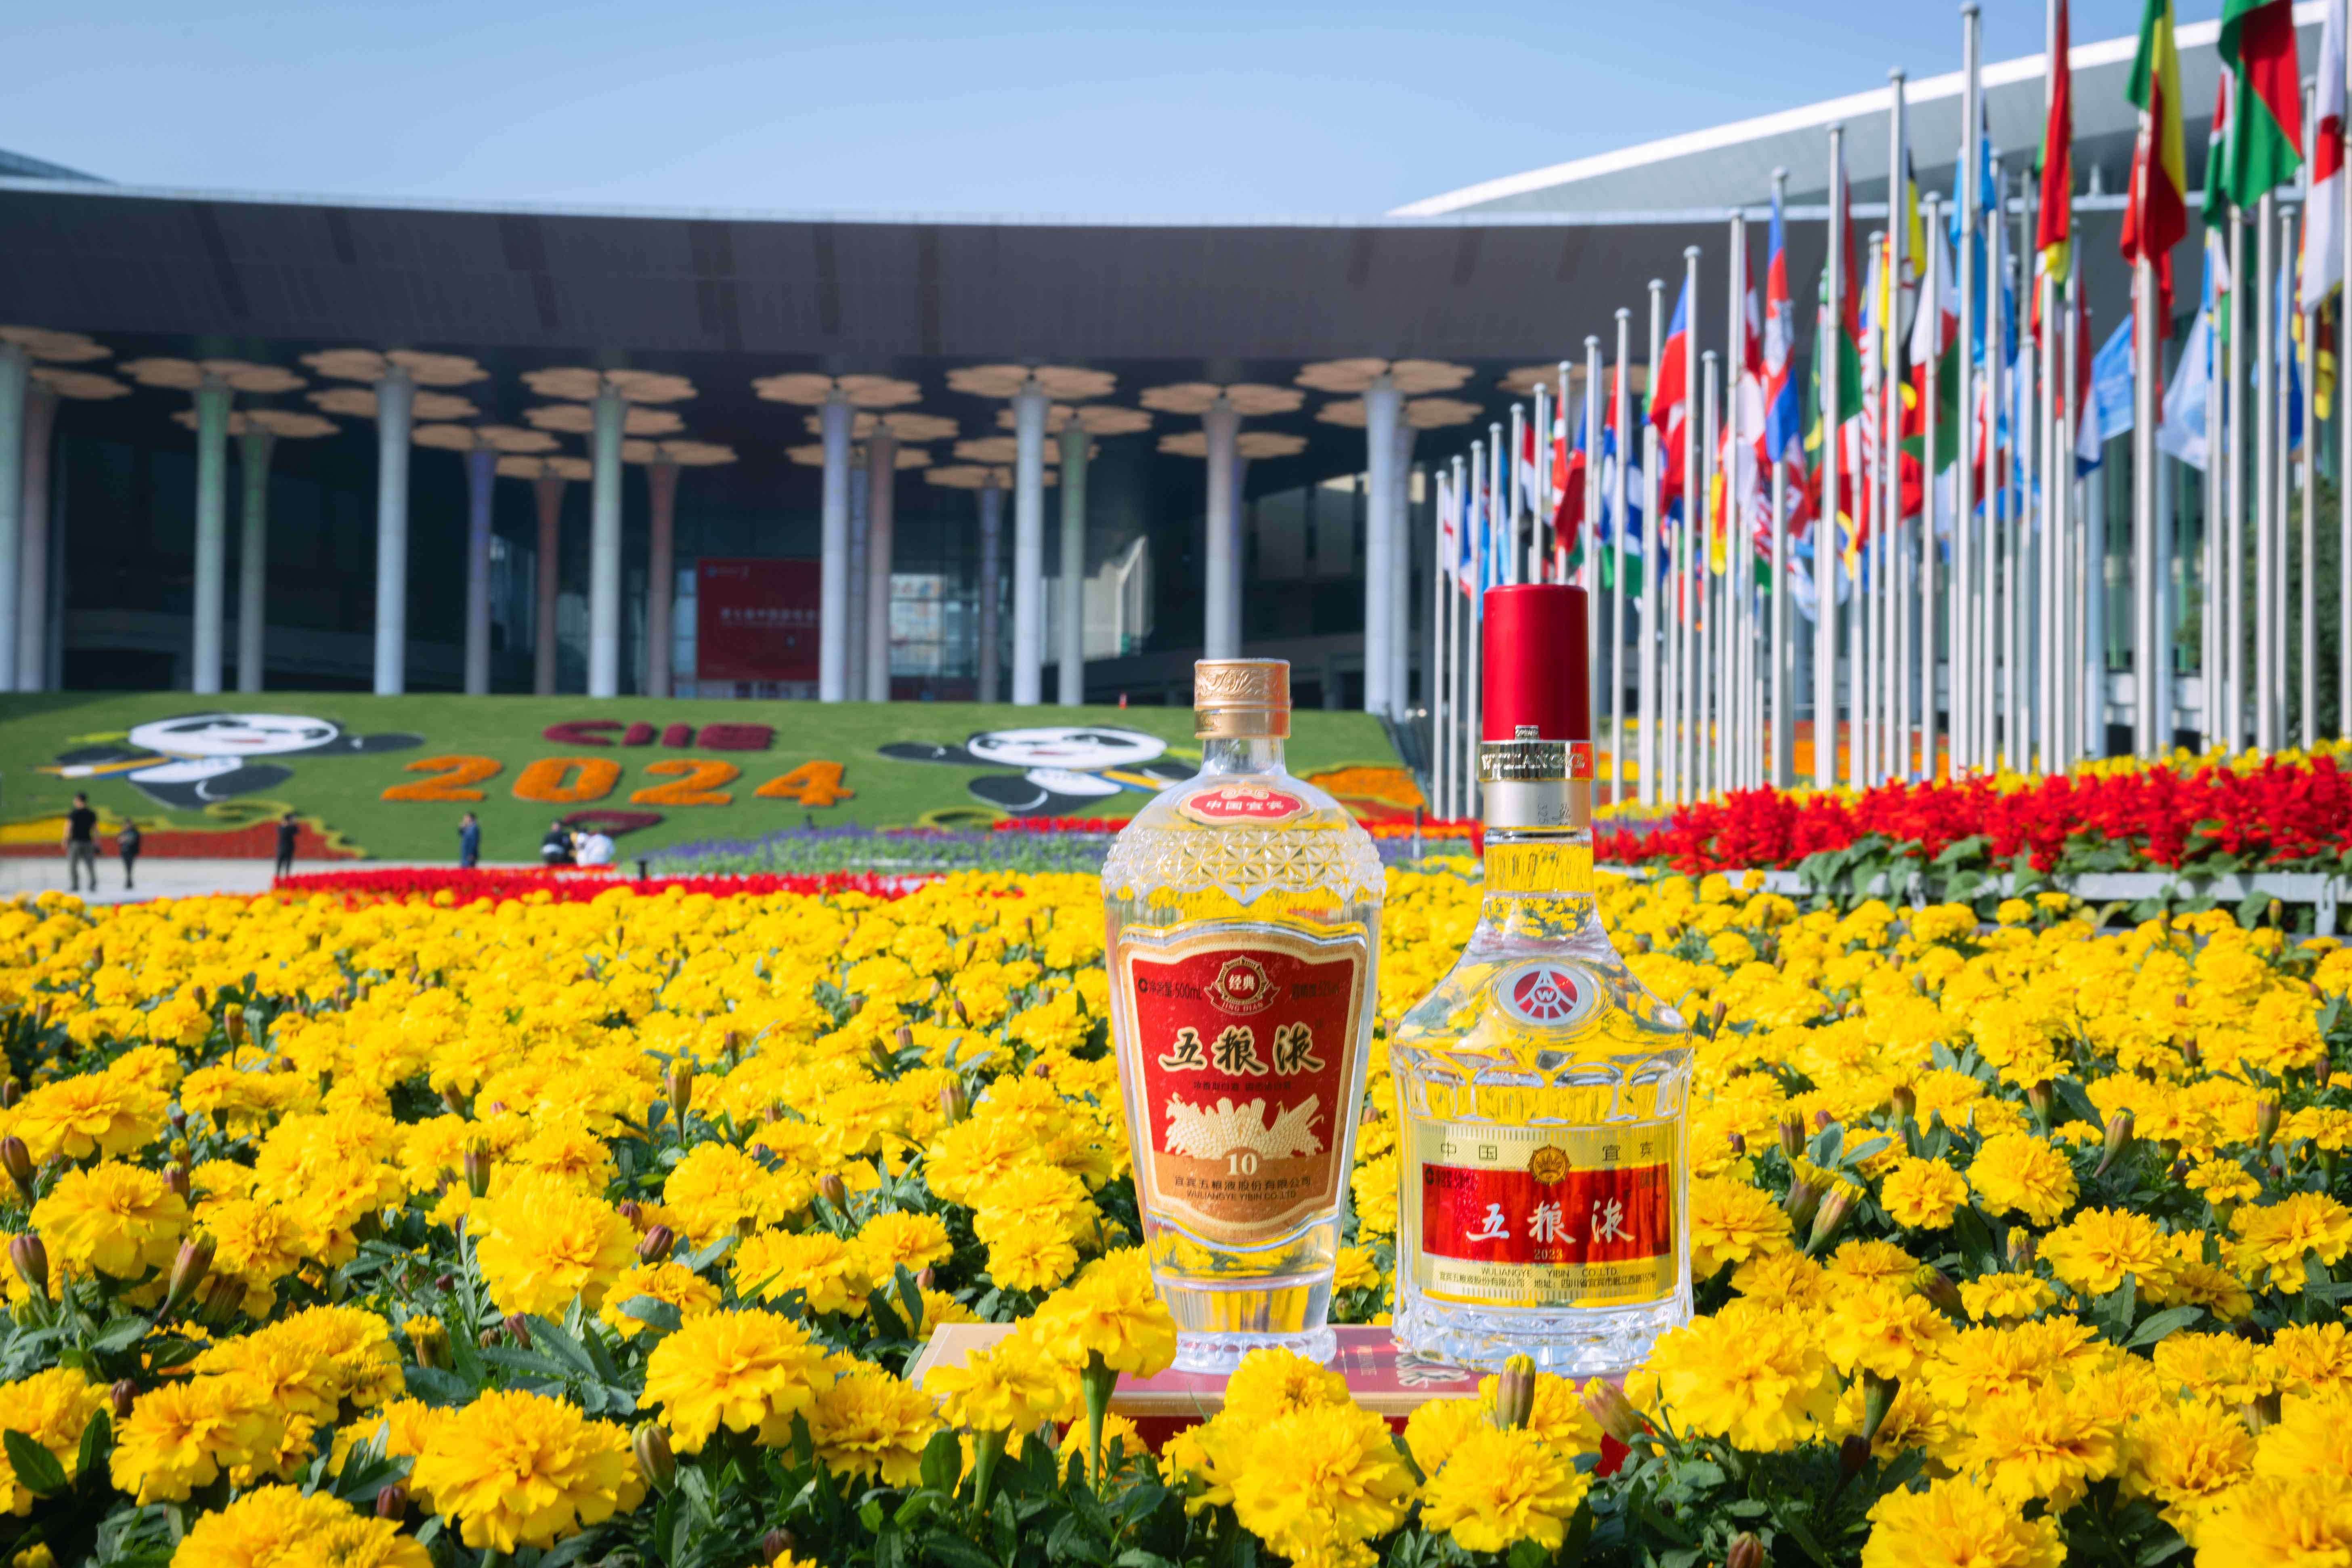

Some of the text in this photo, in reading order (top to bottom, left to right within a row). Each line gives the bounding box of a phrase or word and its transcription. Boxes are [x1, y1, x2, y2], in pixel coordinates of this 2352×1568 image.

[381, 755, 856, 806] 2024
[1206, 800, 1284, 811] 中国宜宾
[1229, 974, 1255, 991] 经典
[1537, 989, 1555, 1000] W
[1159, 1022, 1325, 1076] 五粮液
[1441, 1142, 1655, 1161] 中国 宜宾
[1226, 1153, 1258, 1176] 10
[1175, 1175, 1311, 1191] 宜宾五粮液股份有限公司
[1187, 1190, 1237, 1201] WULIANGYE
[1240, 1191, 1262, 1202] YIBIN
[1466, 1197, 1635, 1245] 五粮液
[1534, 1248, 1563, 1261] 2023
[1440, 1272, 1525, 1287] 宜宾五粮液股份有限公司
[1481, 1266, 1532, 1278] WULIANGYE
[1546, 1269, 1569, 1278] YIBIN
